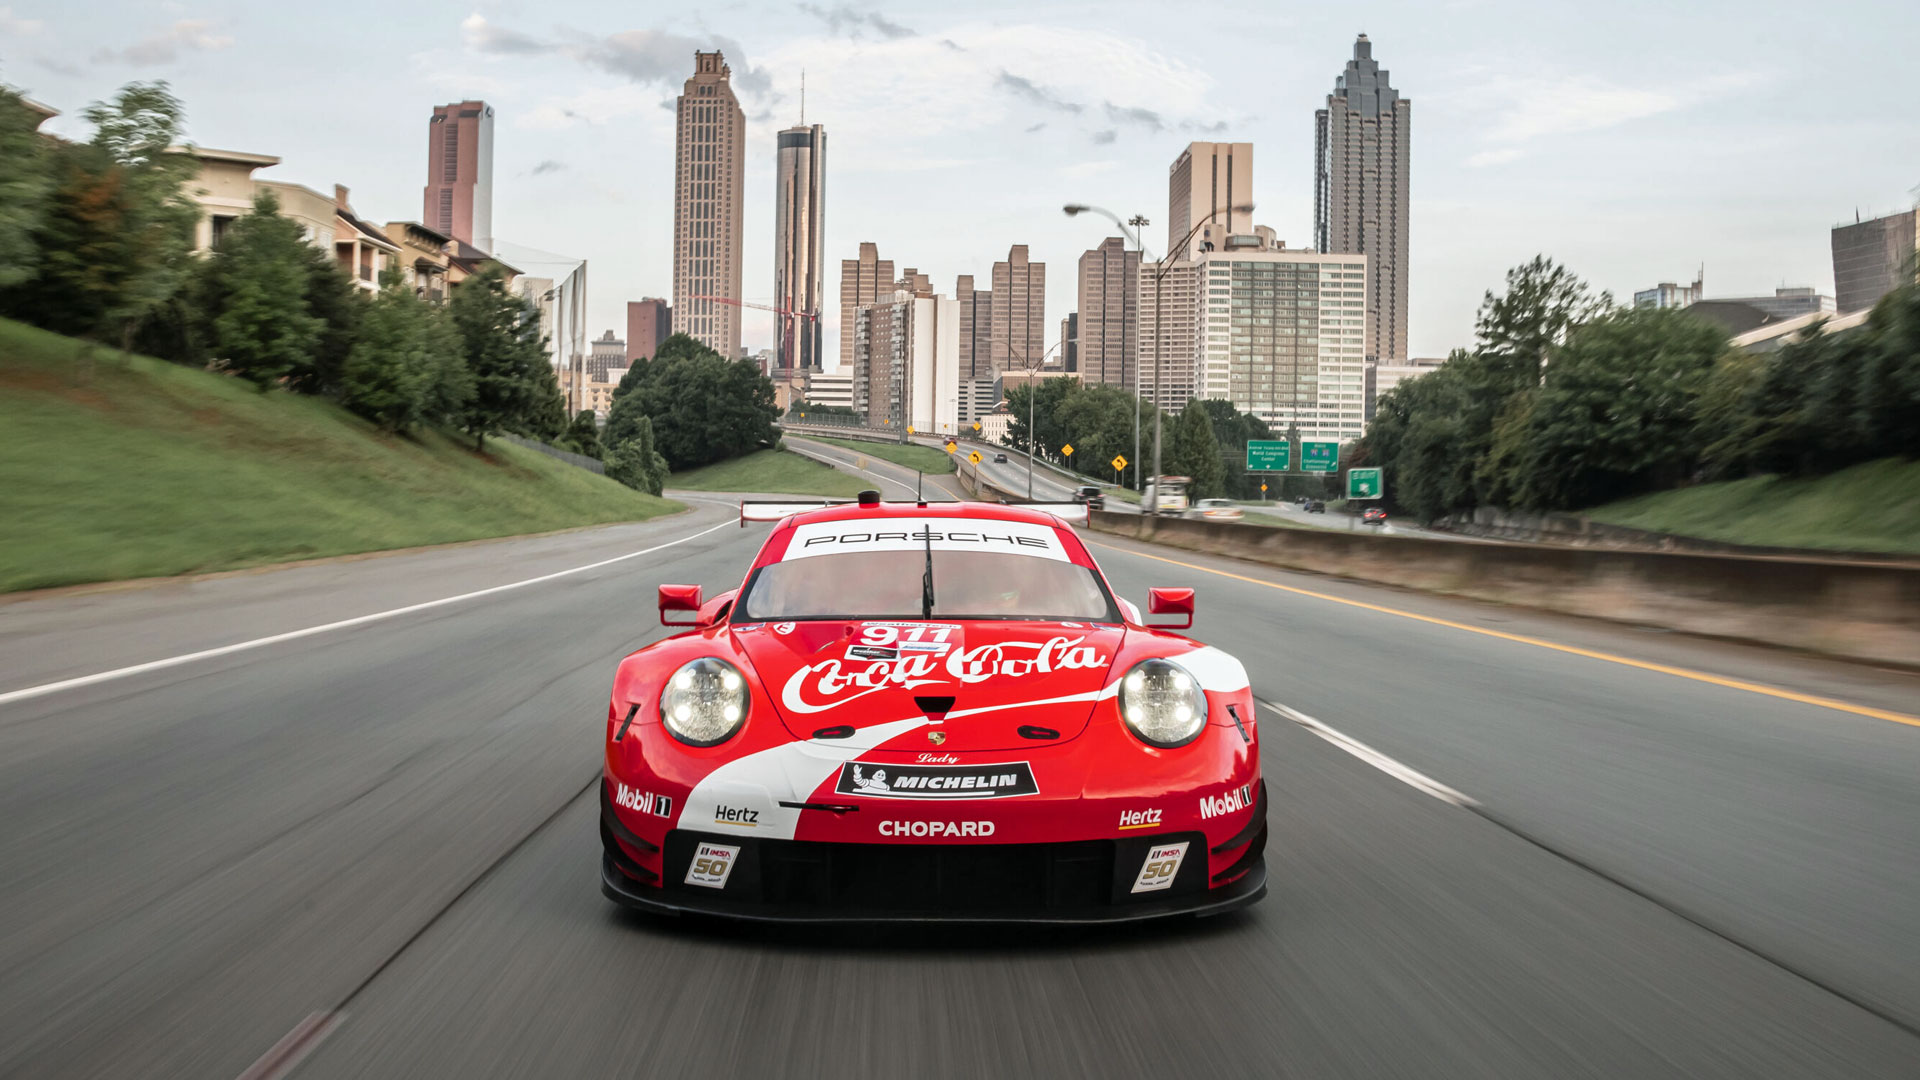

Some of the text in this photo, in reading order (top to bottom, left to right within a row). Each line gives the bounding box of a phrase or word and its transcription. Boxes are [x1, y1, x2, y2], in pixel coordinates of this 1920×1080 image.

[804, 532, 1049, 549] PORSCHE
[860, 626, 952, 645] 911
[915, 753, 960, 764] Lady
[893, 774, 1017, 789] MICHELIN
[616, 783, 654, 814] Mobil
[1200, 791, 1242, 820] Mobil
[715, 804, 759, 823] Hertz
[1119, 807, 1162, 826] Hertz
[878, 820, 995, 837] CHOPARD
[710, 849, 731, 858] IMSA
[1161, 849, 1180, 858] IMSA
[694, 858, 728, 876] 50
[1143, 860, 1177, 879] 50
